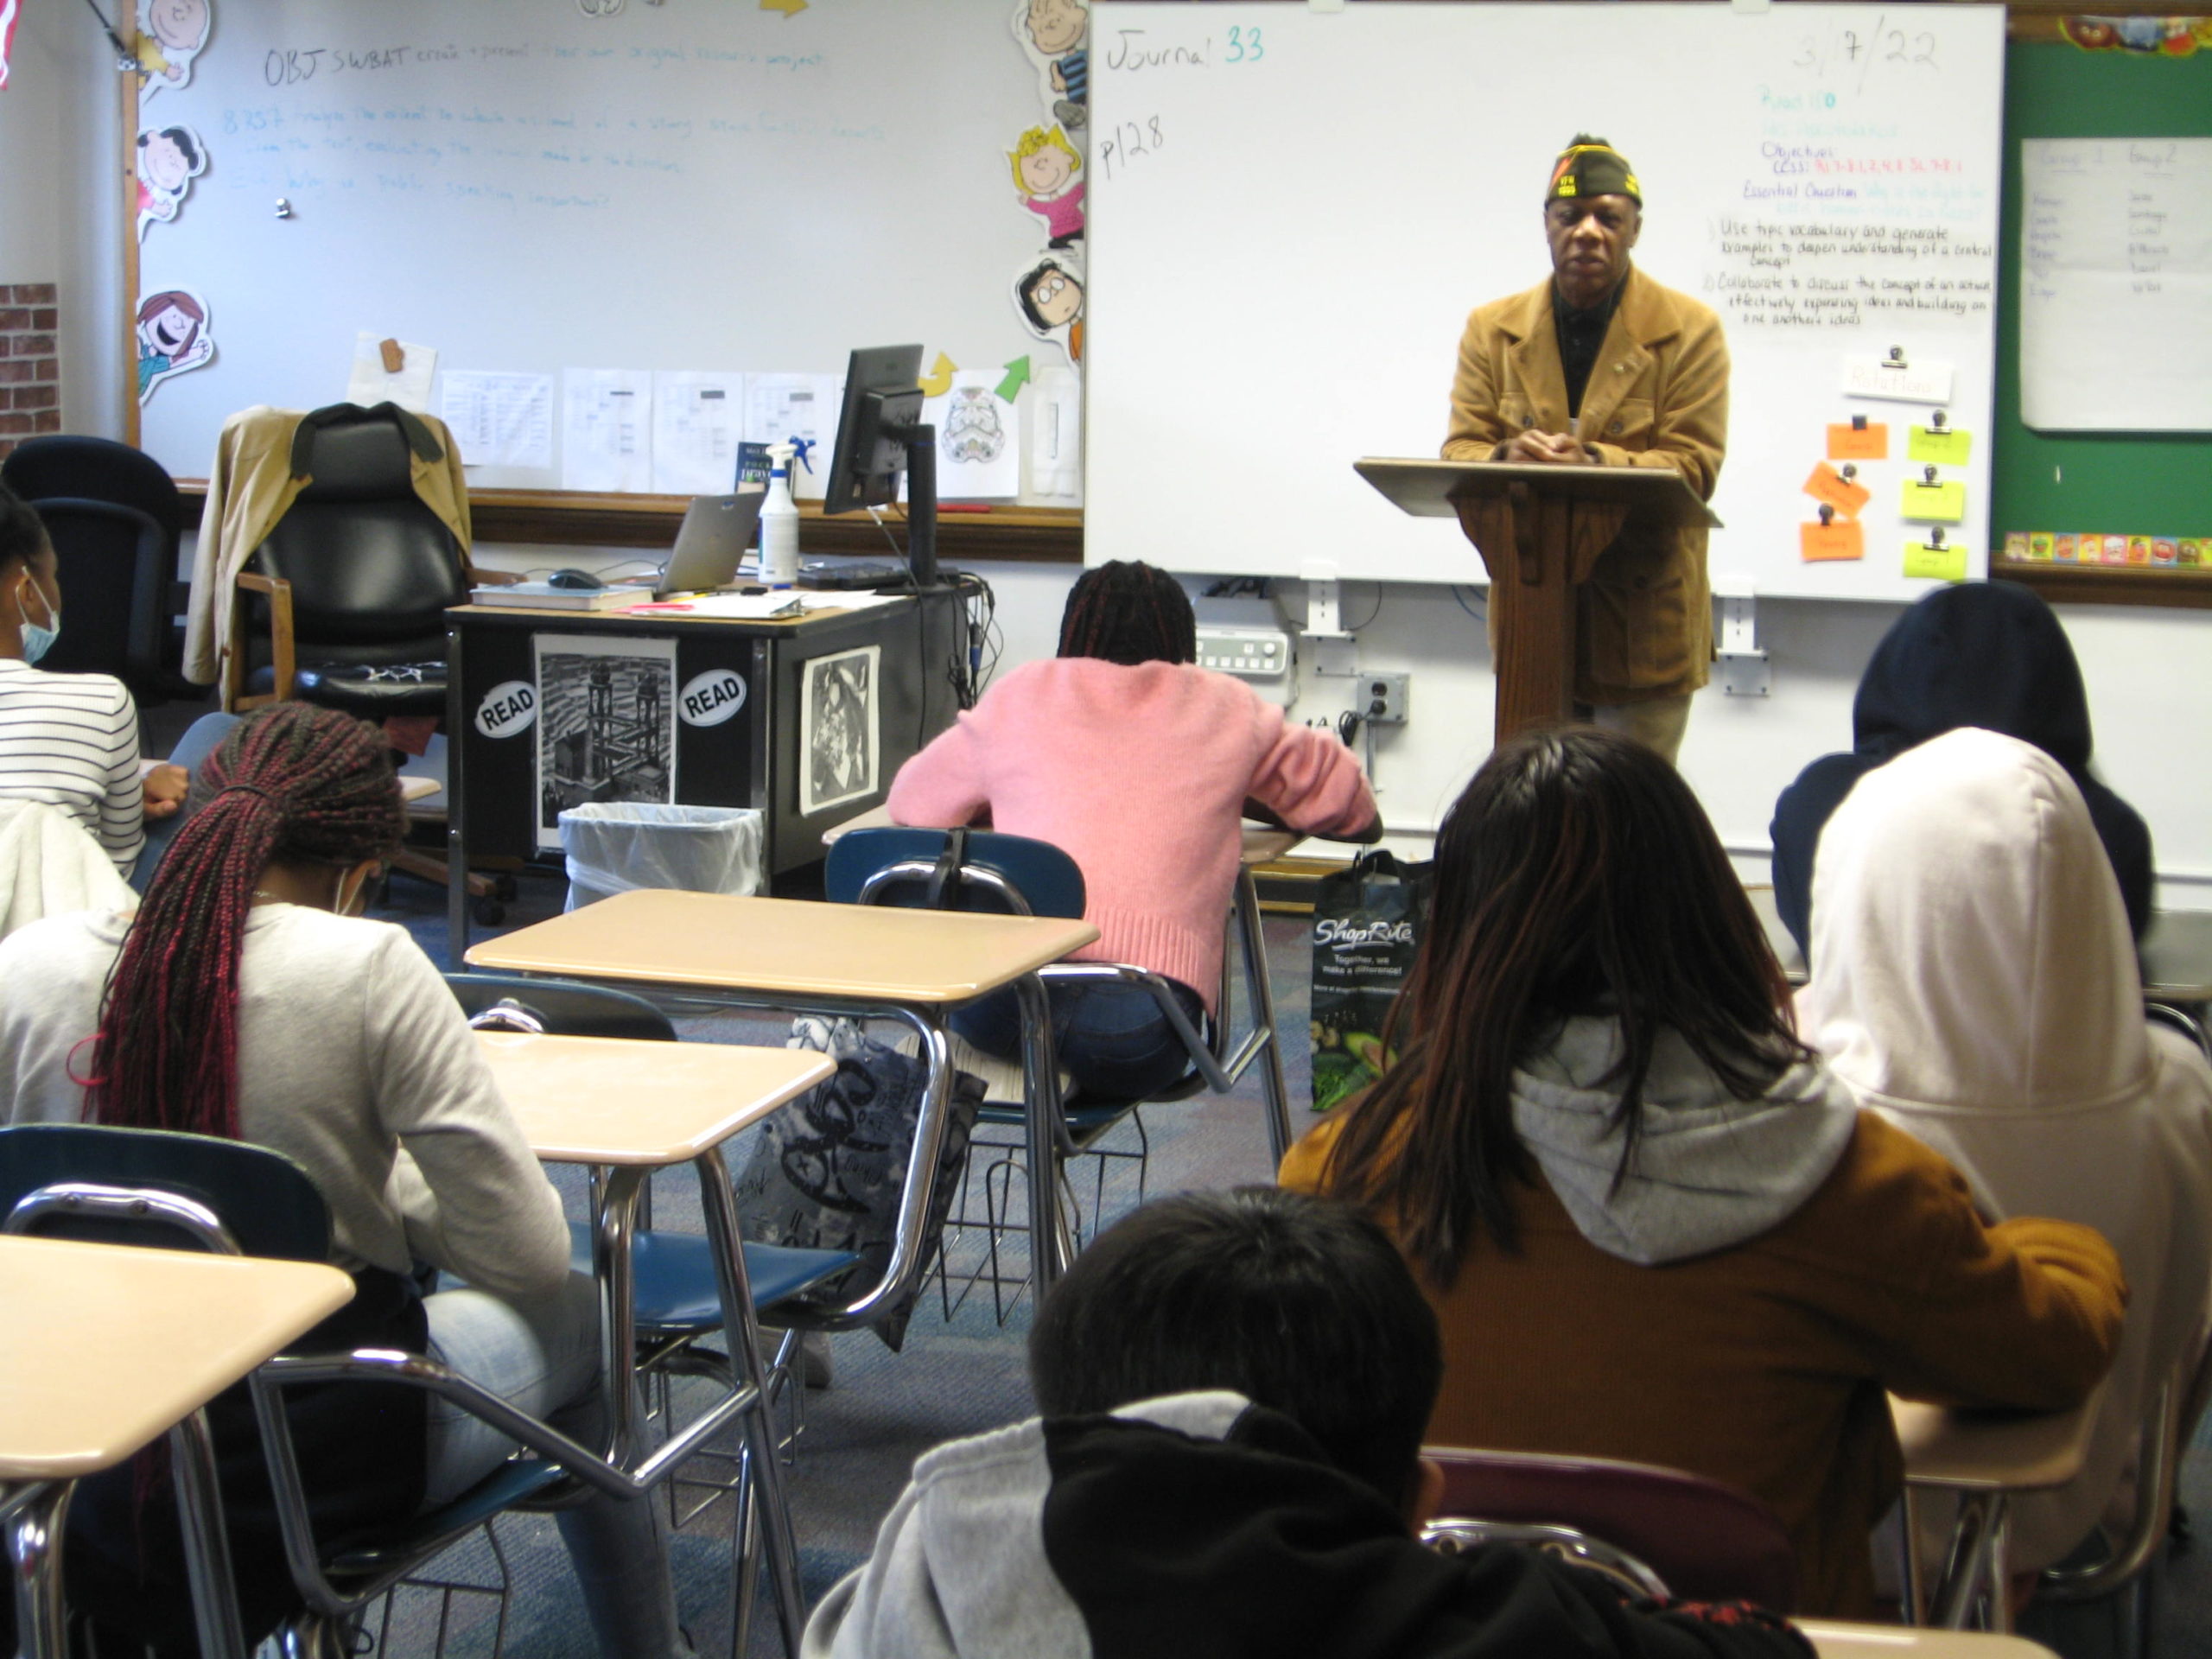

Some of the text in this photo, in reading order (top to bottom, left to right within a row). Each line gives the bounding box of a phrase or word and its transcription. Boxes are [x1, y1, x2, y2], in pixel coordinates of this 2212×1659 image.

[1107, 25, 1264, 70] Journal 33
[265, 48, 327, 86] OBJ
[1742, 179, 1798, 200] Essential
[1721, 219, 1748, 235] Use
[1789, 219, 1859, 238] vocabulary
[1863, 225, 1886, 238] and
[1891, 224, 1949, 245] generate
[1781, 243, 1792, 252] to
[1796, 241, 1837, 257] deepen
[1841, 240, 1917, 260] understanding
[1941, 246, 1949, 255] a
[1718, 270, 1783, 289] Collaborate
[1789, 273, 1800, 289] to
[1807, 276, 1849, 290] discuss
[1856, 274, 1876, 289] the
[1881, 277, 1921, 294] concept
[1924, 276, 1936, 289] of
[1865, 295, 1891, 307] ideas
[1896, 296, 1915, 308] and
[1916, 295, 1967, 315] building
[1743, 313, 1764, 324] one
[1829, 313, 1861, 326] ideas
[480, 689, 534, 731] READ
[684, 677, 740, 718] READ
[1313, 918, 1414, 950] ShopRite
[1354, 966, 1402, 976] difference!
